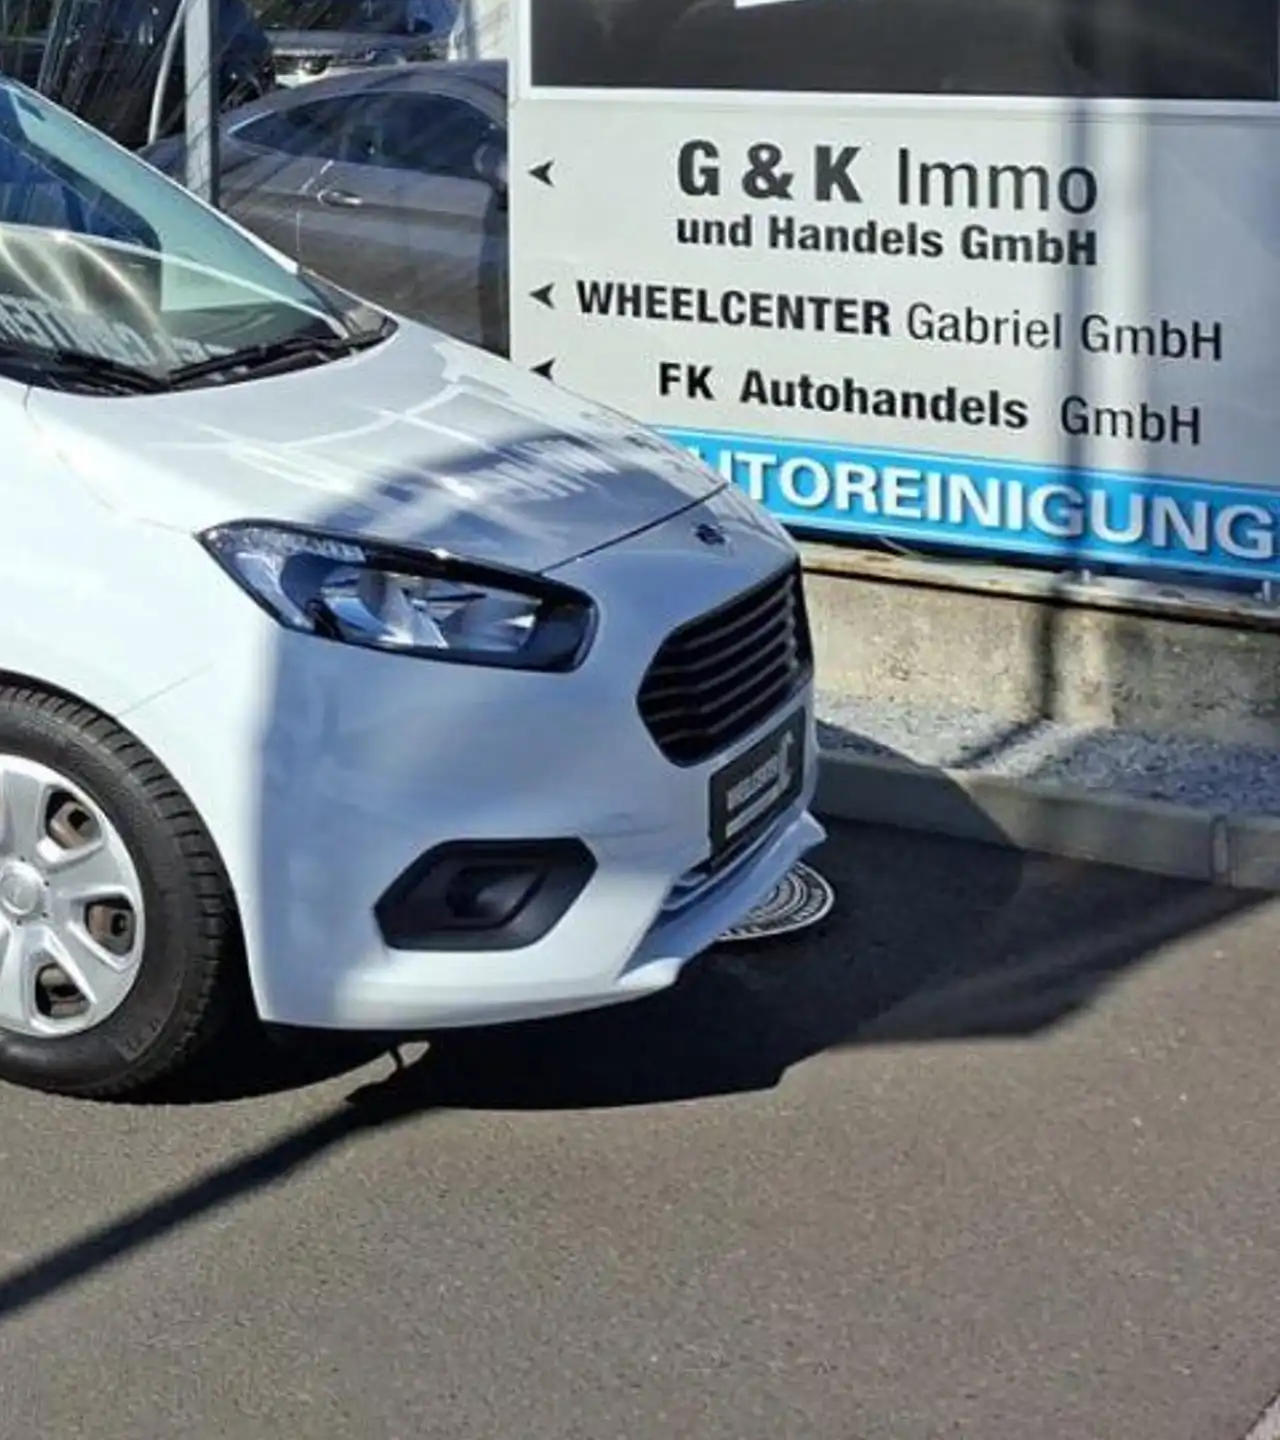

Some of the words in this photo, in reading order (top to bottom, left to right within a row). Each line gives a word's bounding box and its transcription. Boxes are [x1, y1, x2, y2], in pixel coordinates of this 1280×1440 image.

[677, 139, 720, 197] G
[741, 142, 794, 200] &
[814, 144, 863, 203] K
[898, 146, 1097, 214] Immo
[676, 214, 752, 248] und
[768, 215, 944, 258] Handels
[960, 224, 1097, 266] GmbH
[576, 279, 891, 337] WHEELCENTER
[906, 301, 1062, 350] Gabriel
[1080, 313, 1223, 361] GmbH
[658, 361, 715, 401] FK
[739, 368, 1029, 430] Autohandels
[1061, 394, 1201, 446] GmbH
